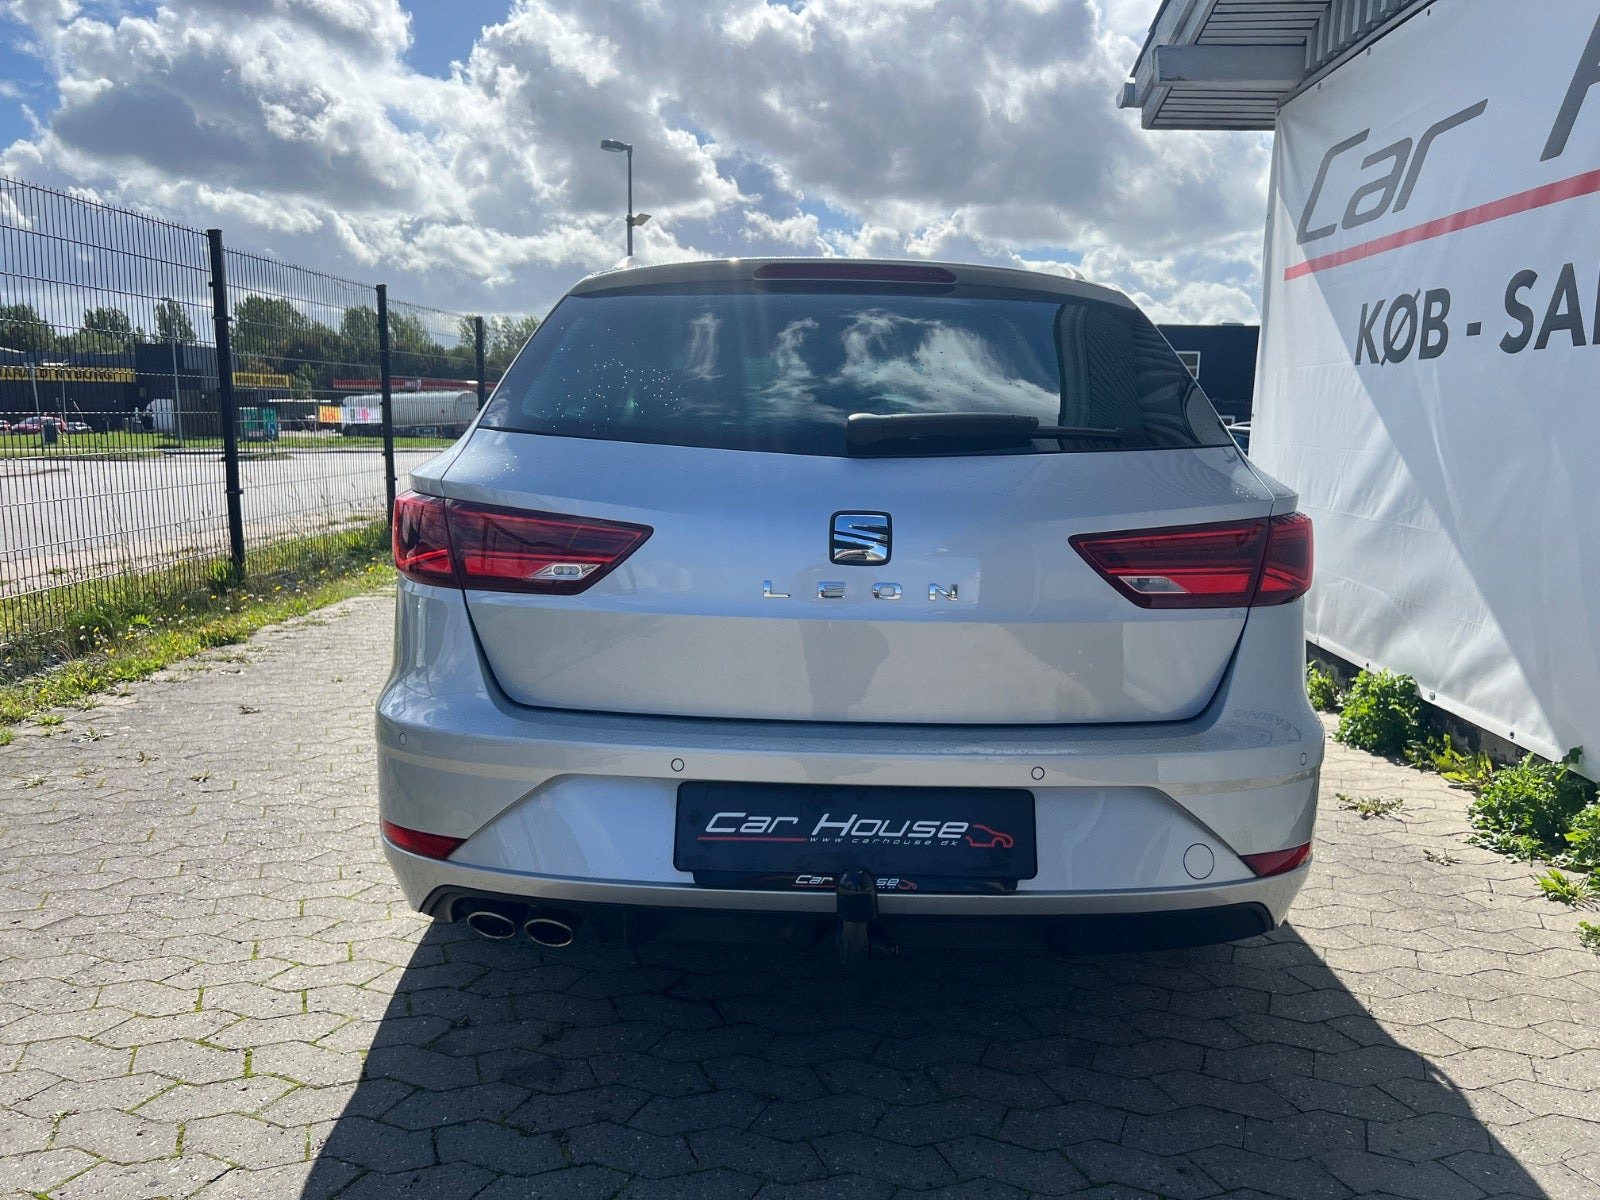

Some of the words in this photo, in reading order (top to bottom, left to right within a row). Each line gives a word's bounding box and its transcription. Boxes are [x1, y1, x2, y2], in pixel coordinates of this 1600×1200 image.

[1297, 99, 1489, 245] Car
[1354, 288, 1452, 366] KØB
[1499, 263, 1600, 354] SA
[763, 580, 958, 601] LEON
[705, 812, 799, 833] Car
[811, 813, 969, 839] House
[795, 874, 833, 885] Car
